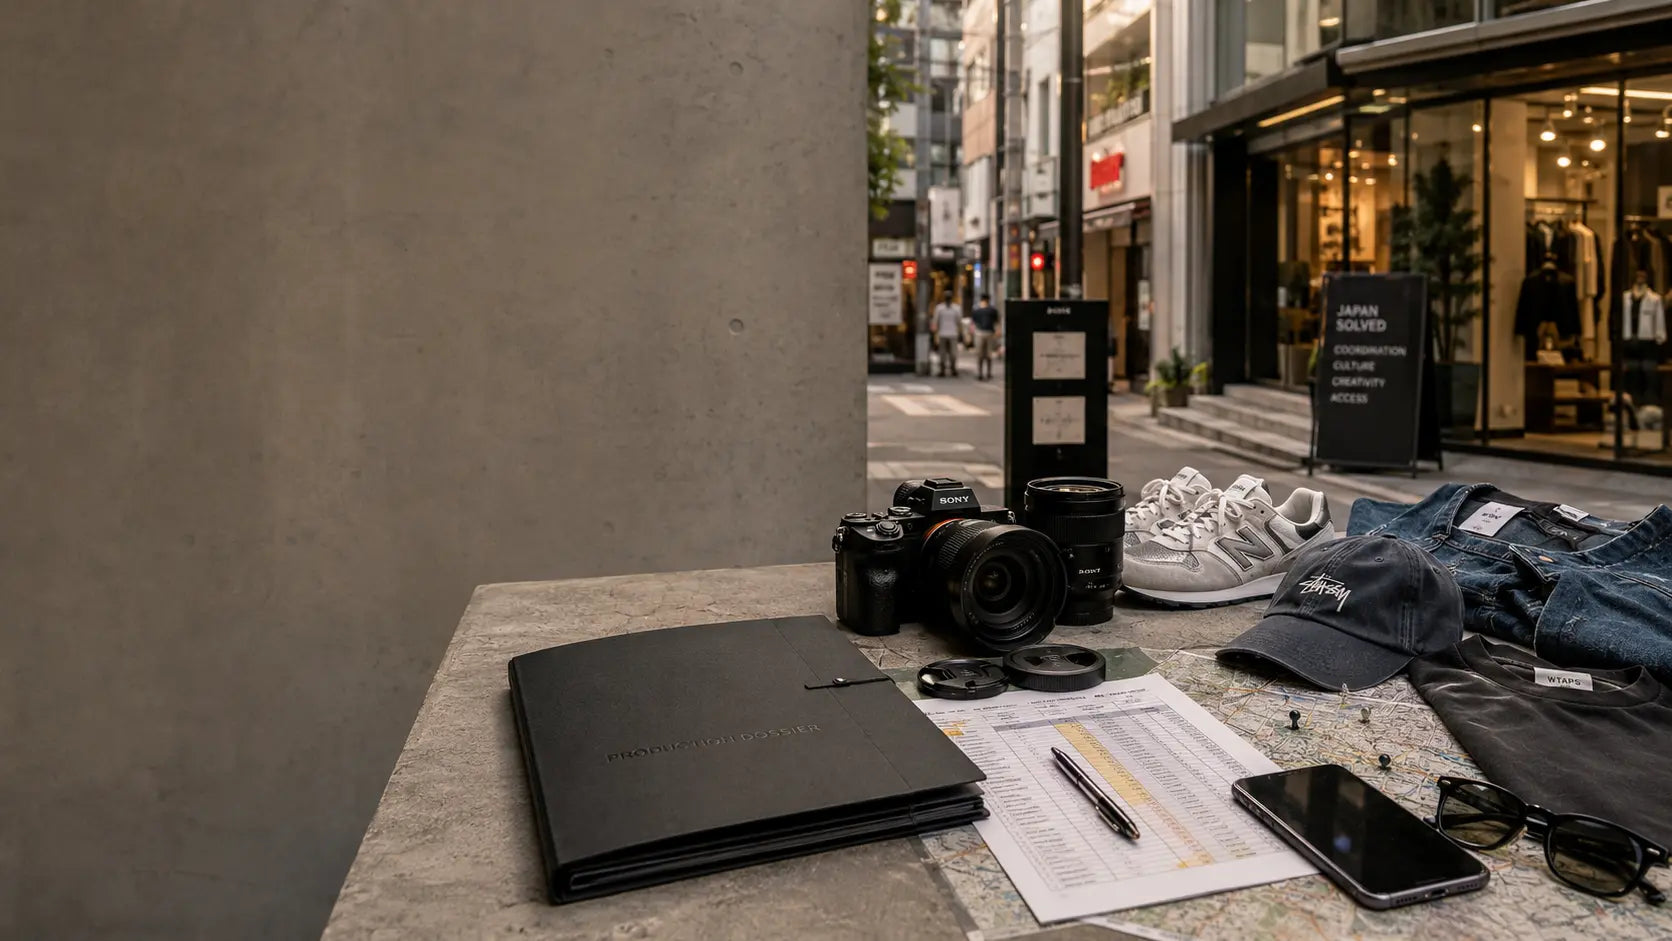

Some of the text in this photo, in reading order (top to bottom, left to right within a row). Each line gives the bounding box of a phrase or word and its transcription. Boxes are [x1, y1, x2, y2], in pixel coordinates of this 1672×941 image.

[1336, 304, 1379, 317] JAPAN
[1336, 318, 1387, 332] SOLVED
[1333, 345, 1407, 357] COORDINATION
[1332, 361, 1375, 372] CULTURE
[1331, 376, 1386, 388] CREATIVITY
[1330, 392, 1368, 404] ACCESS
[939, 495, 969, 505] SONY
[1547, 675, 1581, 686] WTAPS
[740, 724, 822, 741] DOSSIER
